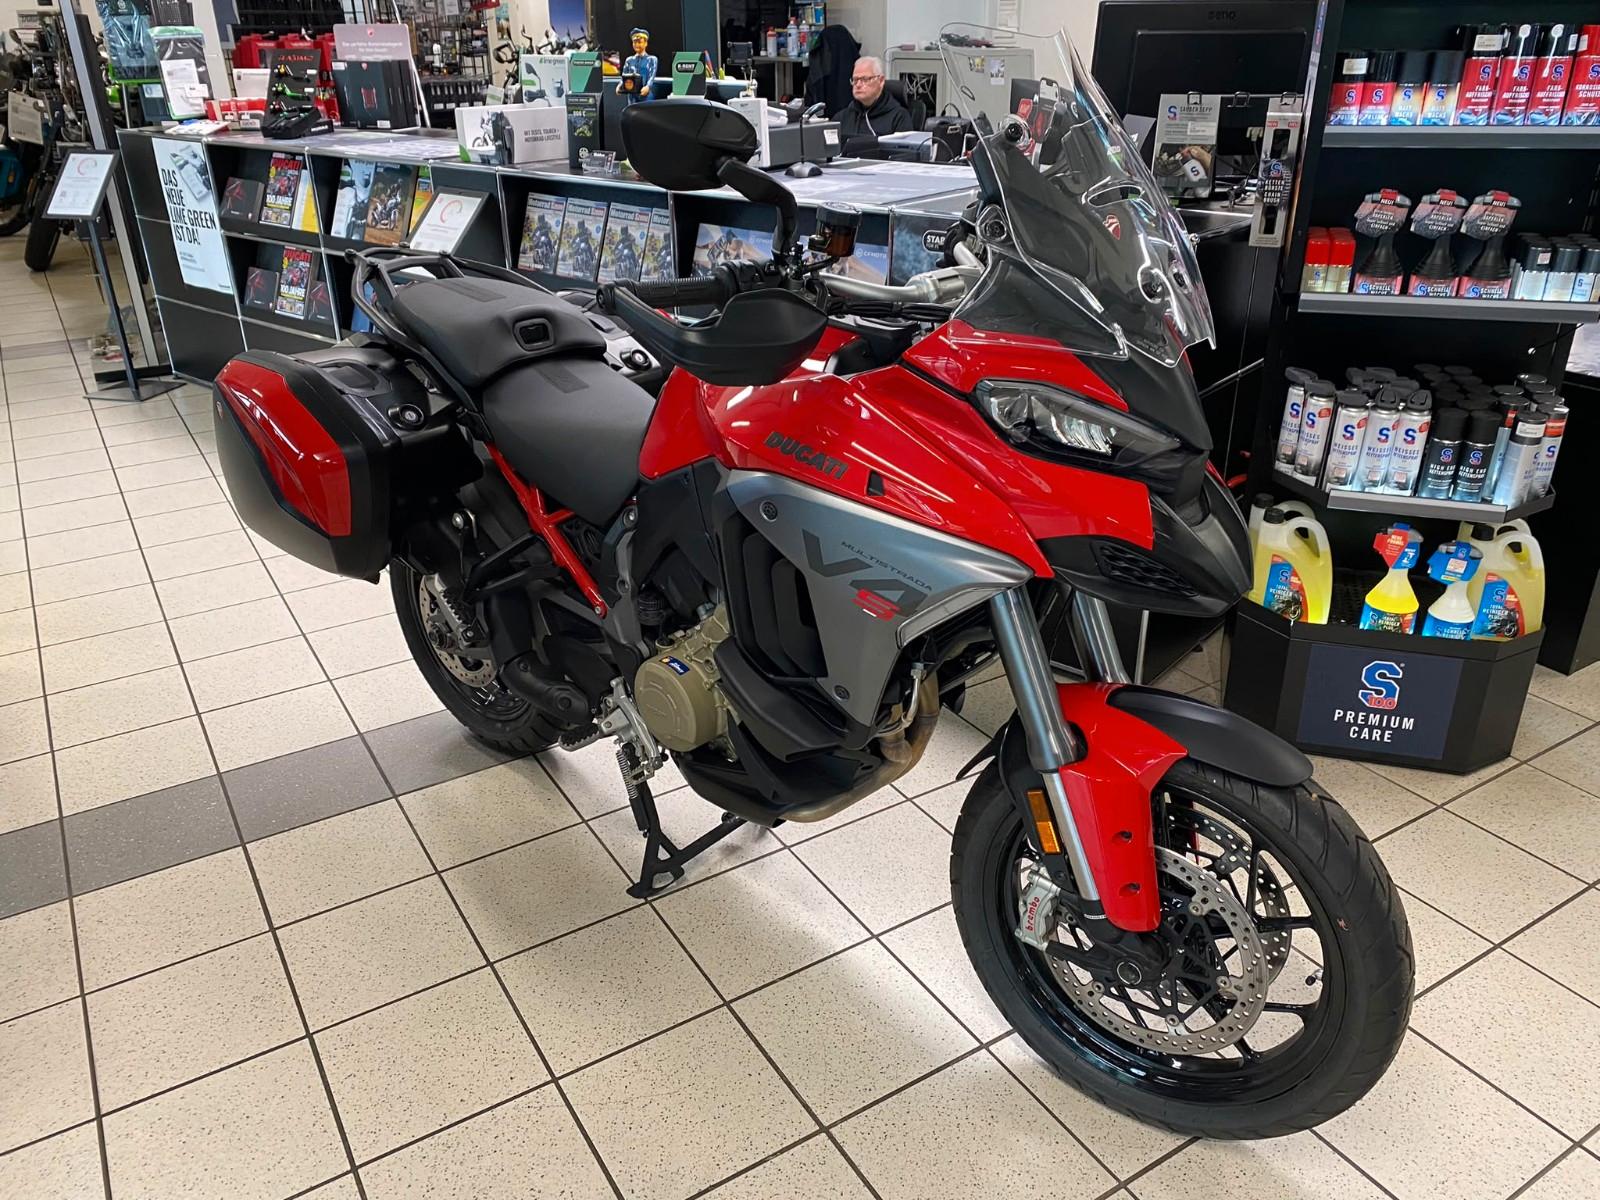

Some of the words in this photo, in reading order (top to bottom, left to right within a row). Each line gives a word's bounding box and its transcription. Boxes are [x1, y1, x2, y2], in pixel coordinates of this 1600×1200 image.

[161, 168, 178, 187] DAS
[165, 187, 186, 207] NEUE
[170, 206, 188, 225] LIME
[187, 210, 217, 230] GREEN
[173, 225, 185, 242] IST
[187, 227, 201, 246] DA!
[764, 431, 849, 480] DUCATI
[840, 541, 932, 591] MULTISTRADA
[1334, 709, 1415, 730] PREMIUM
[1349, 726, 1393, 743] CARE
[1025, 896, 1041, 931] brembo
